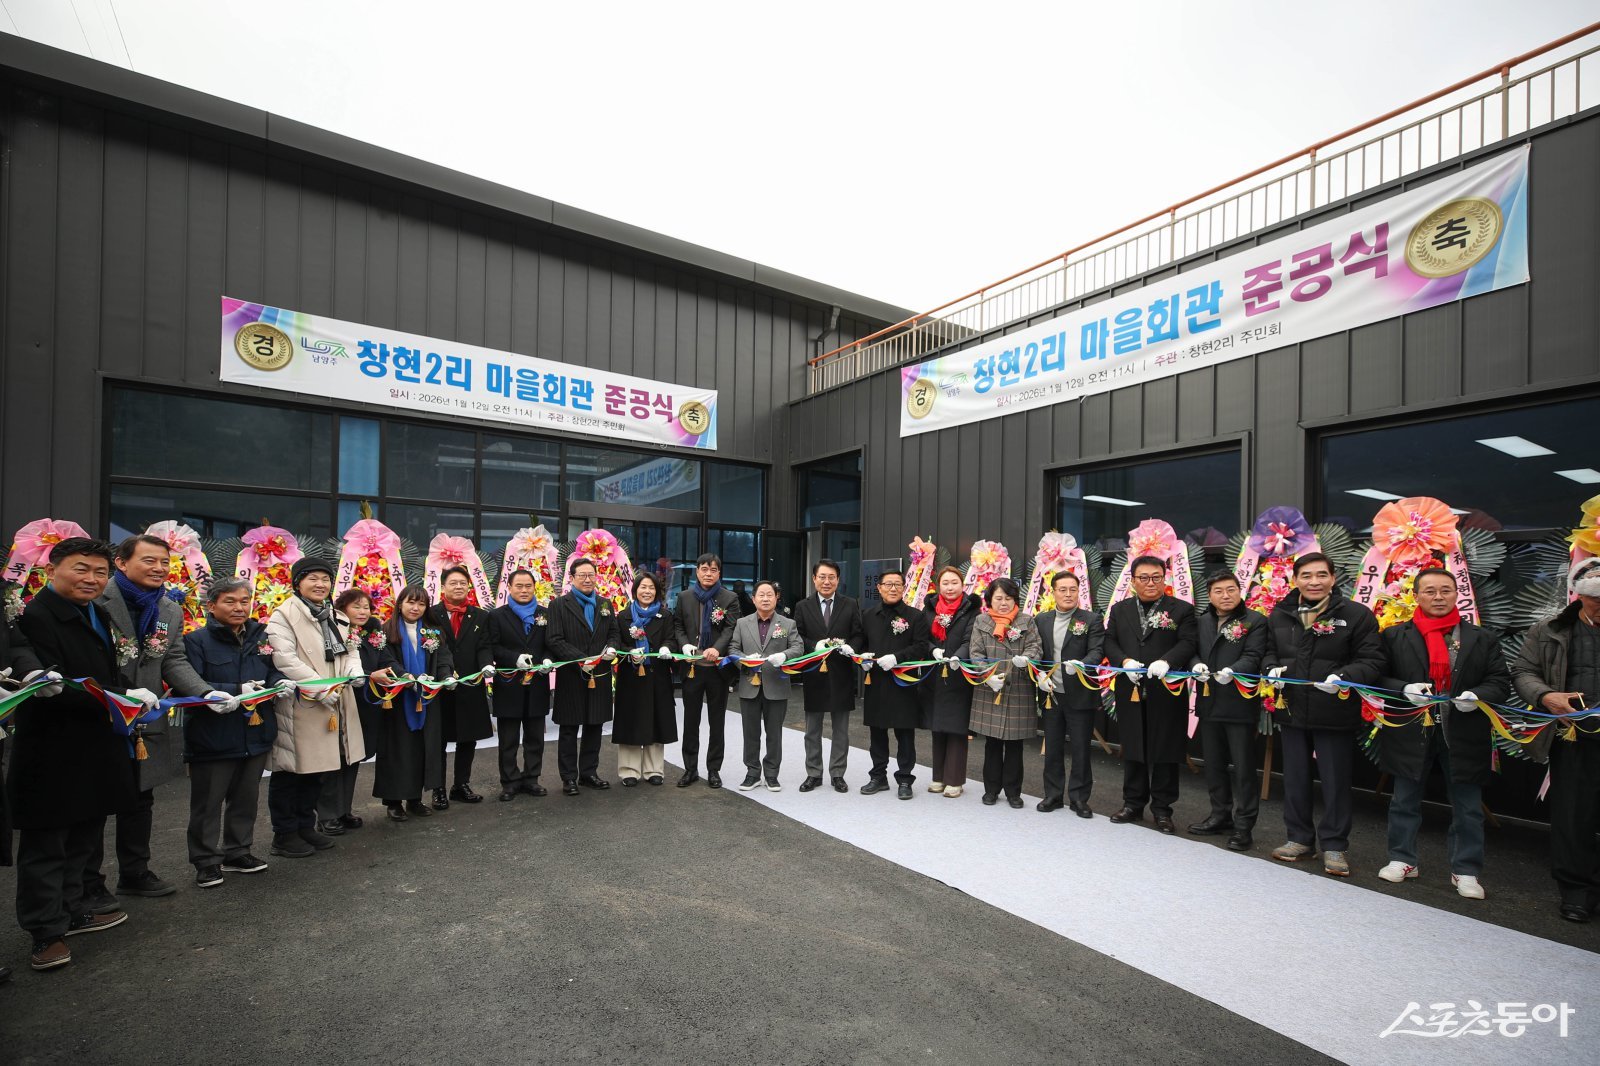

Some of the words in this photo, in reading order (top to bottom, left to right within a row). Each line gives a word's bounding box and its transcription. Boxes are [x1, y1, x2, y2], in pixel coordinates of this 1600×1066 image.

[1431, 216, 1471, 251] 축
[972, 331, 1066, 394] 창현2리
[1079, 279, 1224, 361] 마을회관
[1241, 221, 1390, 318] 준공식
[253, 333, 274, 357] 경
[311, 354, 338, 366] 남양주
[996, 392, 1012, 408] 일시
[1018, 387, 1046, 402] 2026년
[1050, 383, 1062, 394] 1월
[1066, 377, 1085, 390] 12일
[1088, 369, 1108, 385] 오전
[1112, 362, 1135, 378] 11시
[1153, 352, 1178, 368] 주관
[1188, 335, 1235, 359] 창현2리
[1240, 322, 1283, 345] 주민회
[356, 340, 472, 392] 창현2리
[486, 362, 595, 411] 마을회관
[604, 384, 673, 424] 준공식
[915, 386, 927, 407] 경
[945, 388, 961, 398] 남양주
[389, 388, 409, 400] 일시
[418, 393, 450, 406] 2026년
[454, 399, 467, 409] 1월
[472, 401, 490, 412] 12일
[492, 404, 511, 415] 오전
[514, 408, 533, 418] 11시
[547, 412, 565, 423] 주관
[571, 415, 600, 428] 창현2리
[602, 420, 626, 432] 주민회
[687, 407, 701, 425] 축
